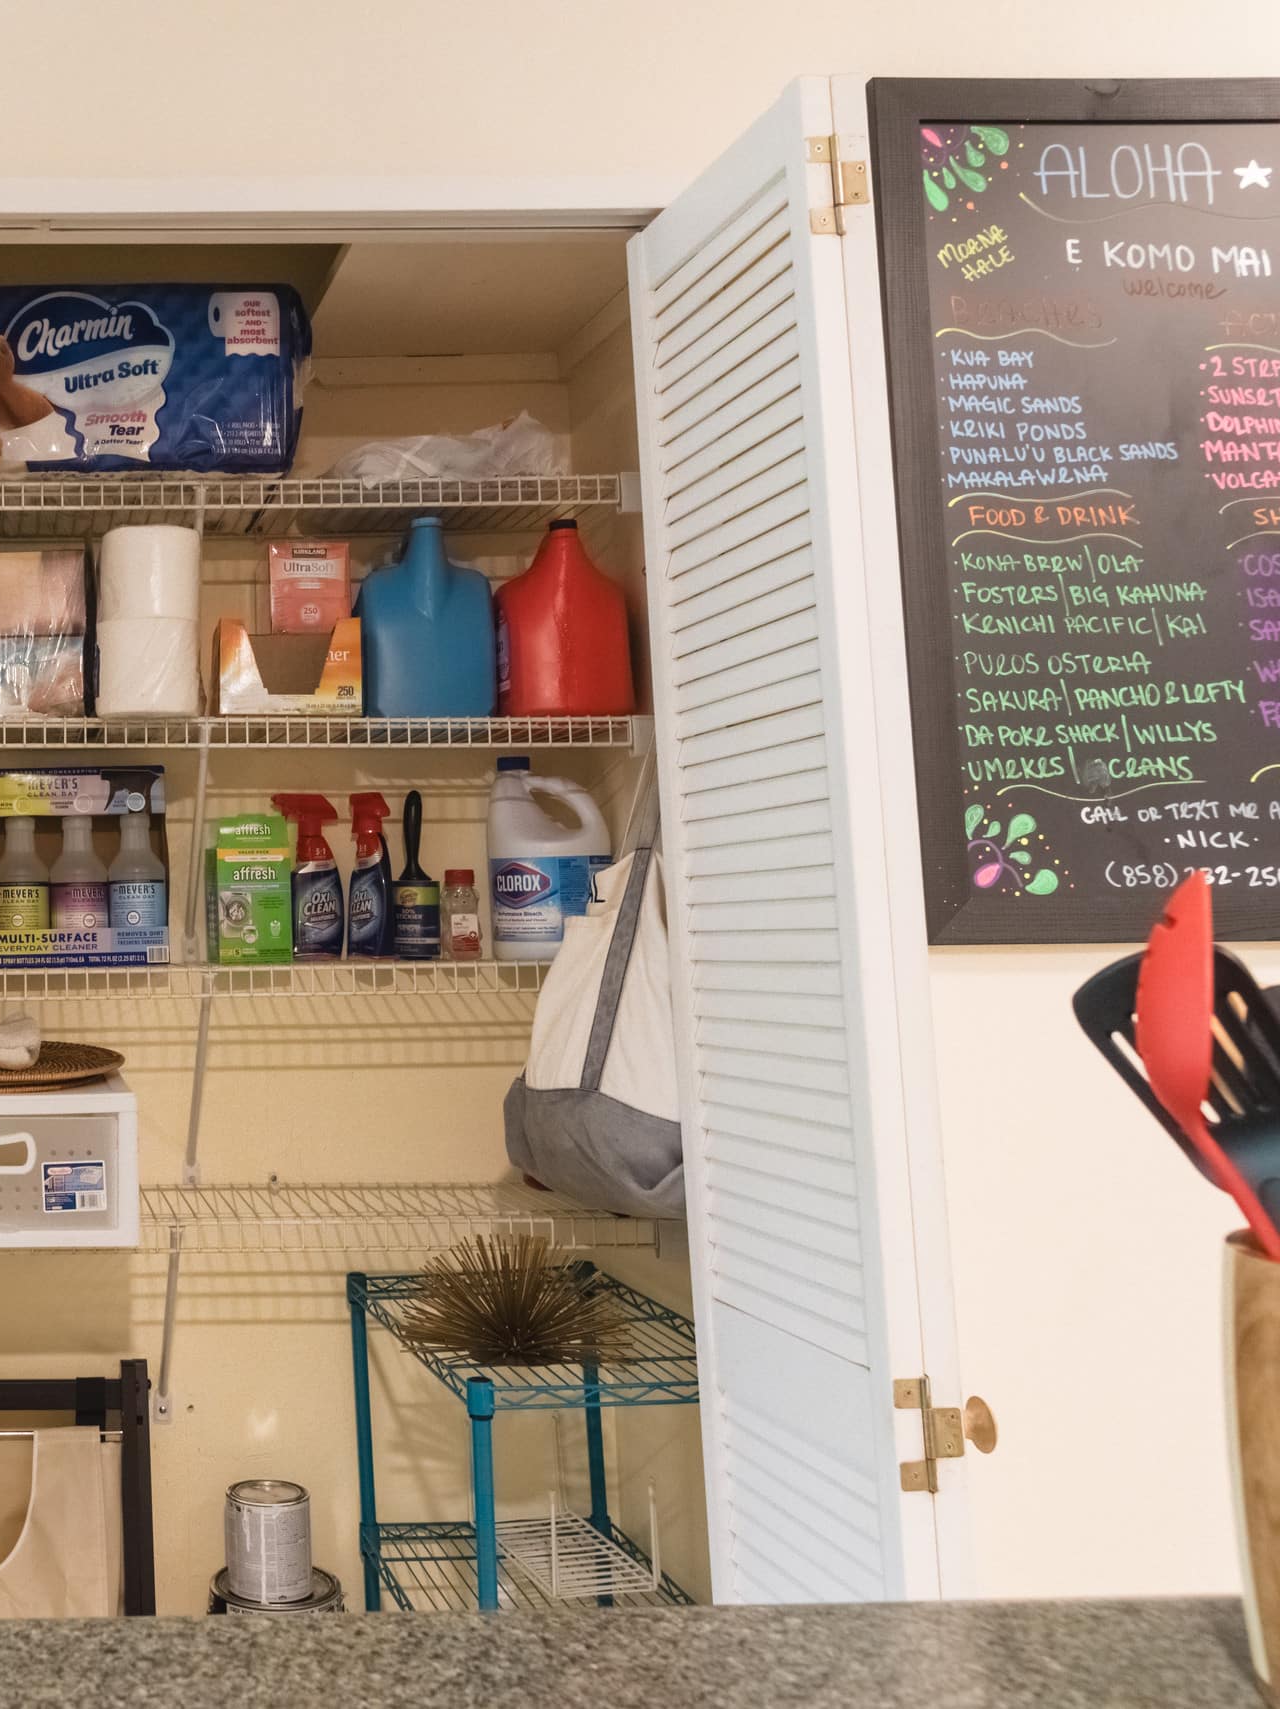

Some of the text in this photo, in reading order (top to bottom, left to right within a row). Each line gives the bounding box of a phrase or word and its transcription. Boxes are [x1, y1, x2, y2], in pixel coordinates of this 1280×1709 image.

[1033, 142, 1222, 205] ALOHA
[961, 245, 1015, 282] HALE
[1066, 239, 1271, 278] E KOMO MAI
[1123, 279, 1228, 301] welcome
[235, 308, 271, 317] softest
[17, 312, 134, 362] Charmin
[227, 336, 278, 345] absorbent
[240, 328, 266, 336] most
[998, 351, 1034, 368] BAY
[1210, 356, 1227, 377] 2
[64, 359, 160, 394] Ultra Soft
[949, 372, 1028, 391] HAPUNA
[948, 396, 1082, 415] MAGIC SANDS
[84, 410, 147, 427] Smooth
[109, 424, 145, 436] Tear
[1016, 423, 1086, 441] PONDS
[1053, 445, 1113, 464] BLACK
[1119, 443, 1179, 460] SANDS
[968, 504, 1140, 528] FOOD & DRINK
[961, 553, 1021, 573] KONA
[1069, 585, 1108, 607] BIG
[1116, 582, 1207, 603] KAHUNA
[303, 607, 318, 615] 250
[1064, 614, 1152, 637] PACIFIC
[1166, 613, 1207, 638] KAI
[338, 686, 354, 696] 250
[966, 687, 1062, 713] SAKURA
[1074, 682, 1160, 711] PANCHO
[965, 724, 994, 747] DA
[1056, 722, 1121, 745] SHACK
[1133, 720, 1218, 745] WILLYS
[1080, 805, 1128, 824] CALL
[1137, 806, 1163, 822] OR
[235, 823, 271, 835] affresh
[1176, 829, 1250, 849] NICK
[233, 866, 276, 880] affresh
[1105, 861, 1179, 888] (858)
[118, 885, 155, 895] MEYER'S
[496, 874, 542, 892] CLOROX
[3, 888, 39, 898] MEYER'S
[312, 891, 330, 904] OXI
[354, 890, 368, 901] OXI
[304, 901, 336, 915] CLEAN
